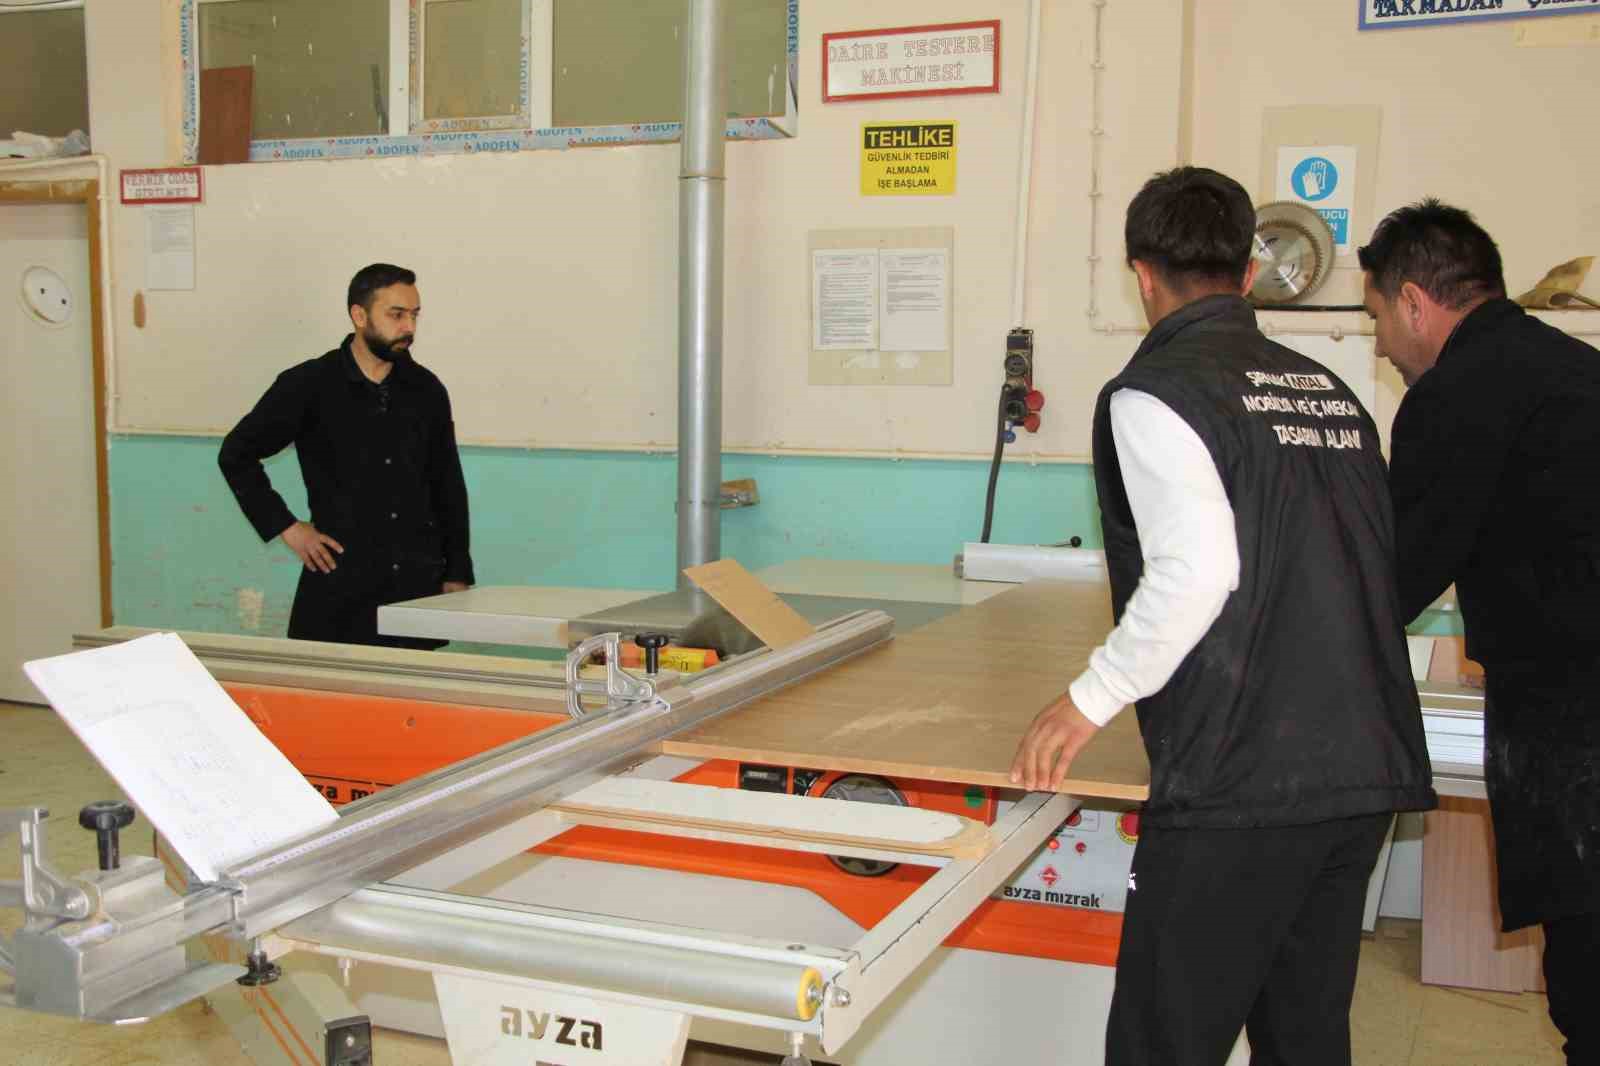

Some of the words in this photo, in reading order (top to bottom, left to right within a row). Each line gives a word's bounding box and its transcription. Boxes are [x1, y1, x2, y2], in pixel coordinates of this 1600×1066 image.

[860, 61, 966, 87] MAKİNESİ
[866, 126, 952, 147] TEHLİKE
[867, 152, 912, 162] GÜVENLİK
[914, 150, 950, 161] TEDBİRİ
[886, 165, 930, 175] ALMADAN
[877, 179, 892, 190] İŞE
[893, 178, 938, 190] BAŞLAMA
[1324, 428, 1362, 449] ALANI
[1004, 885, 1042, 901] ayza
[1045, 889, 1101, 908] mızrak
[500, 1004, 603, 1051] ayza
